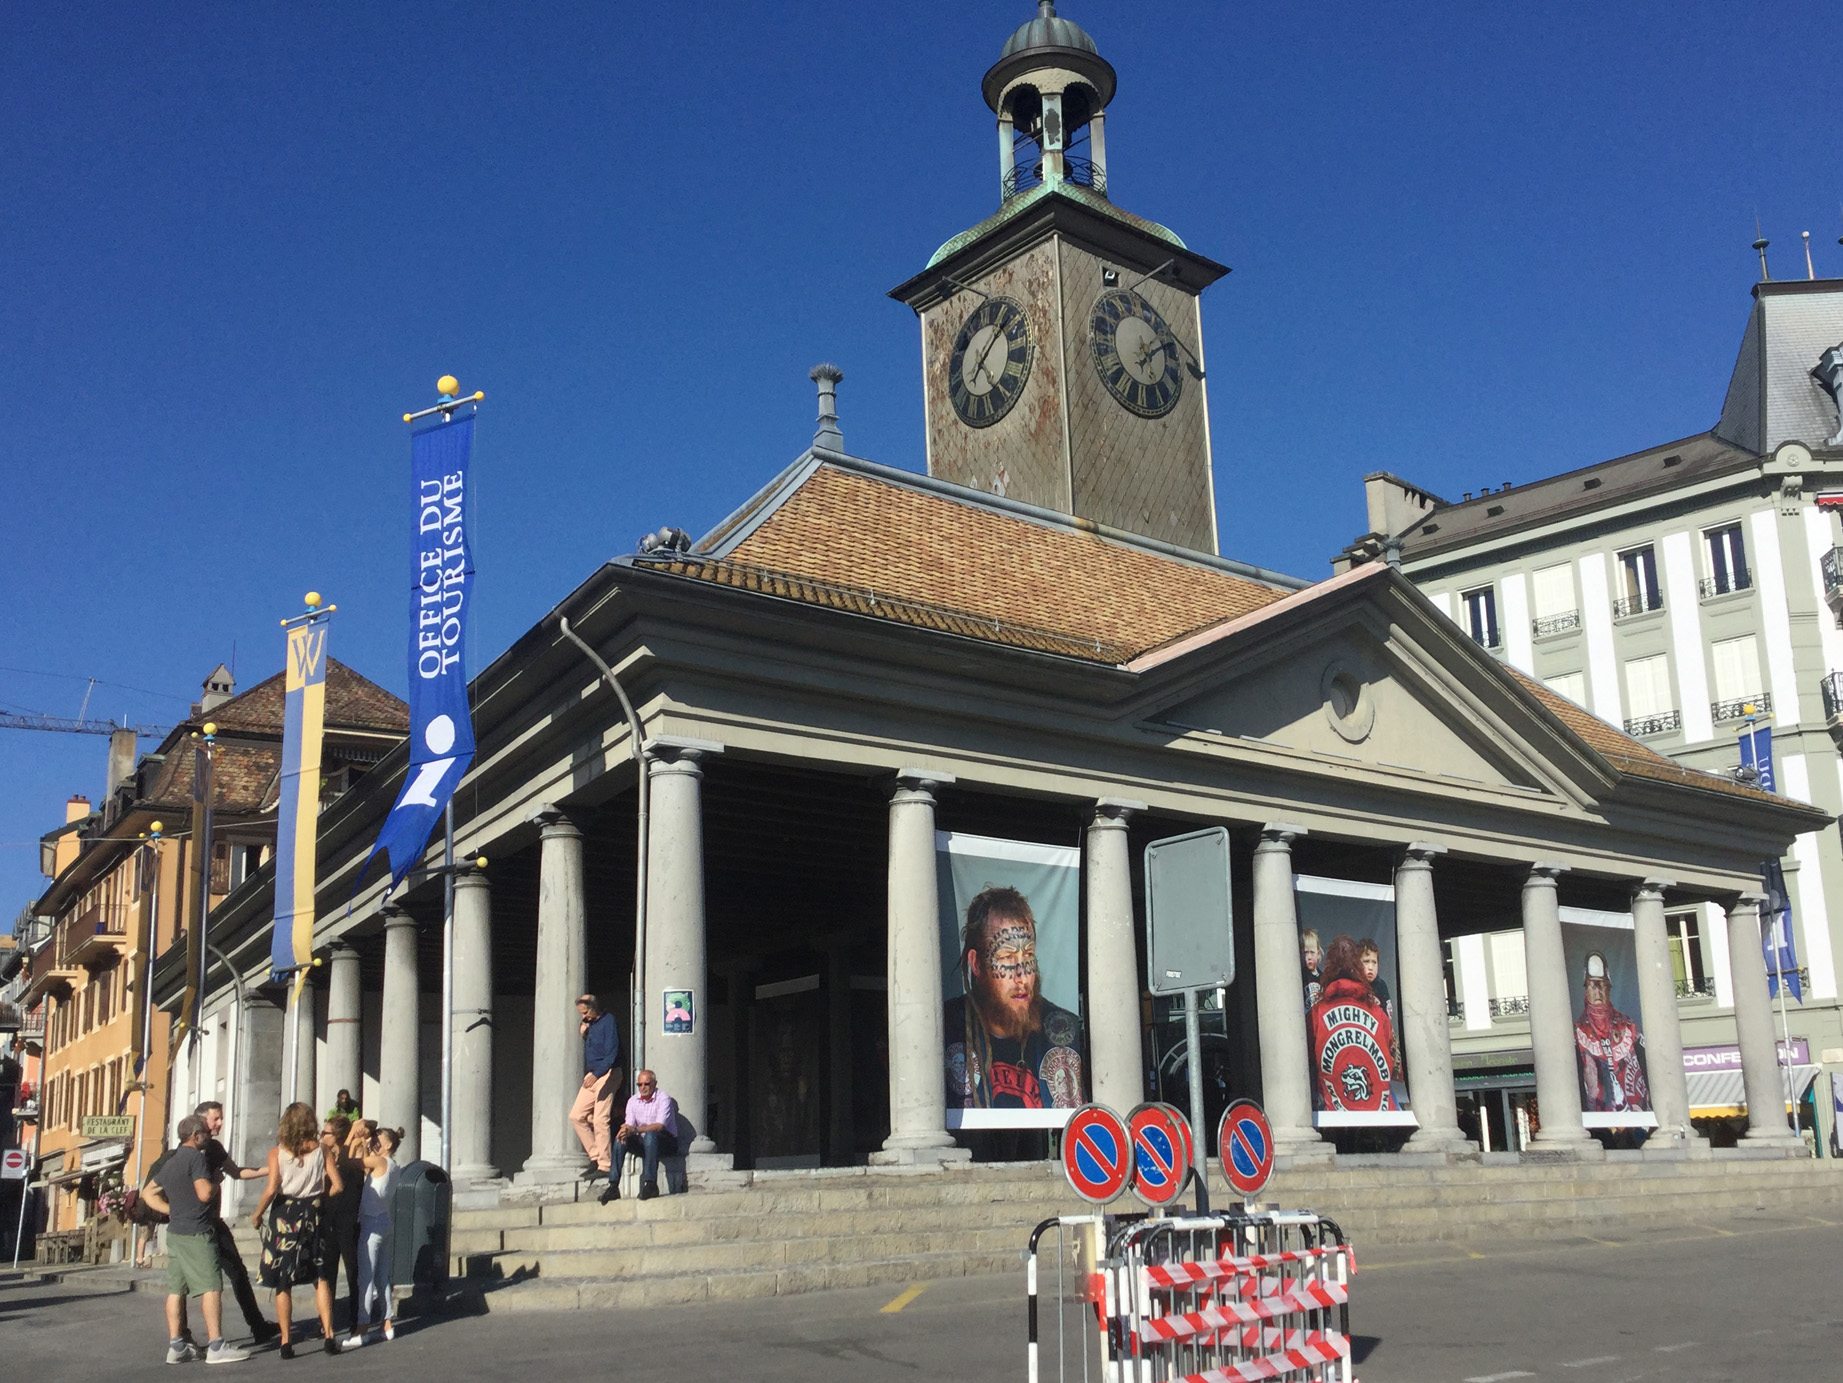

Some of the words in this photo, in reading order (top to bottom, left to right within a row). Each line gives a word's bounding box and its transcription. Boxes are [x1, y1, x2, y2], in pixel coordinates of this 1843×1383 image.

[420, 480, 442, 535] DU
[441, 471, 465, 675] TOURISME
[418, 548, 442, 679] OFFICE
[292, 629, 325, 678] W
[1326, 1007, 1377, 1031] MIGHTY
[1322, 1030, 1368, 1074] MONGREL
[1368, 1042, 1389, 1080] MOB
[86, 1118, 130, 1126] RESTAURANT
[87, 1127, 97, 1135] DE
[100, 1127, 109, 1135] LA
